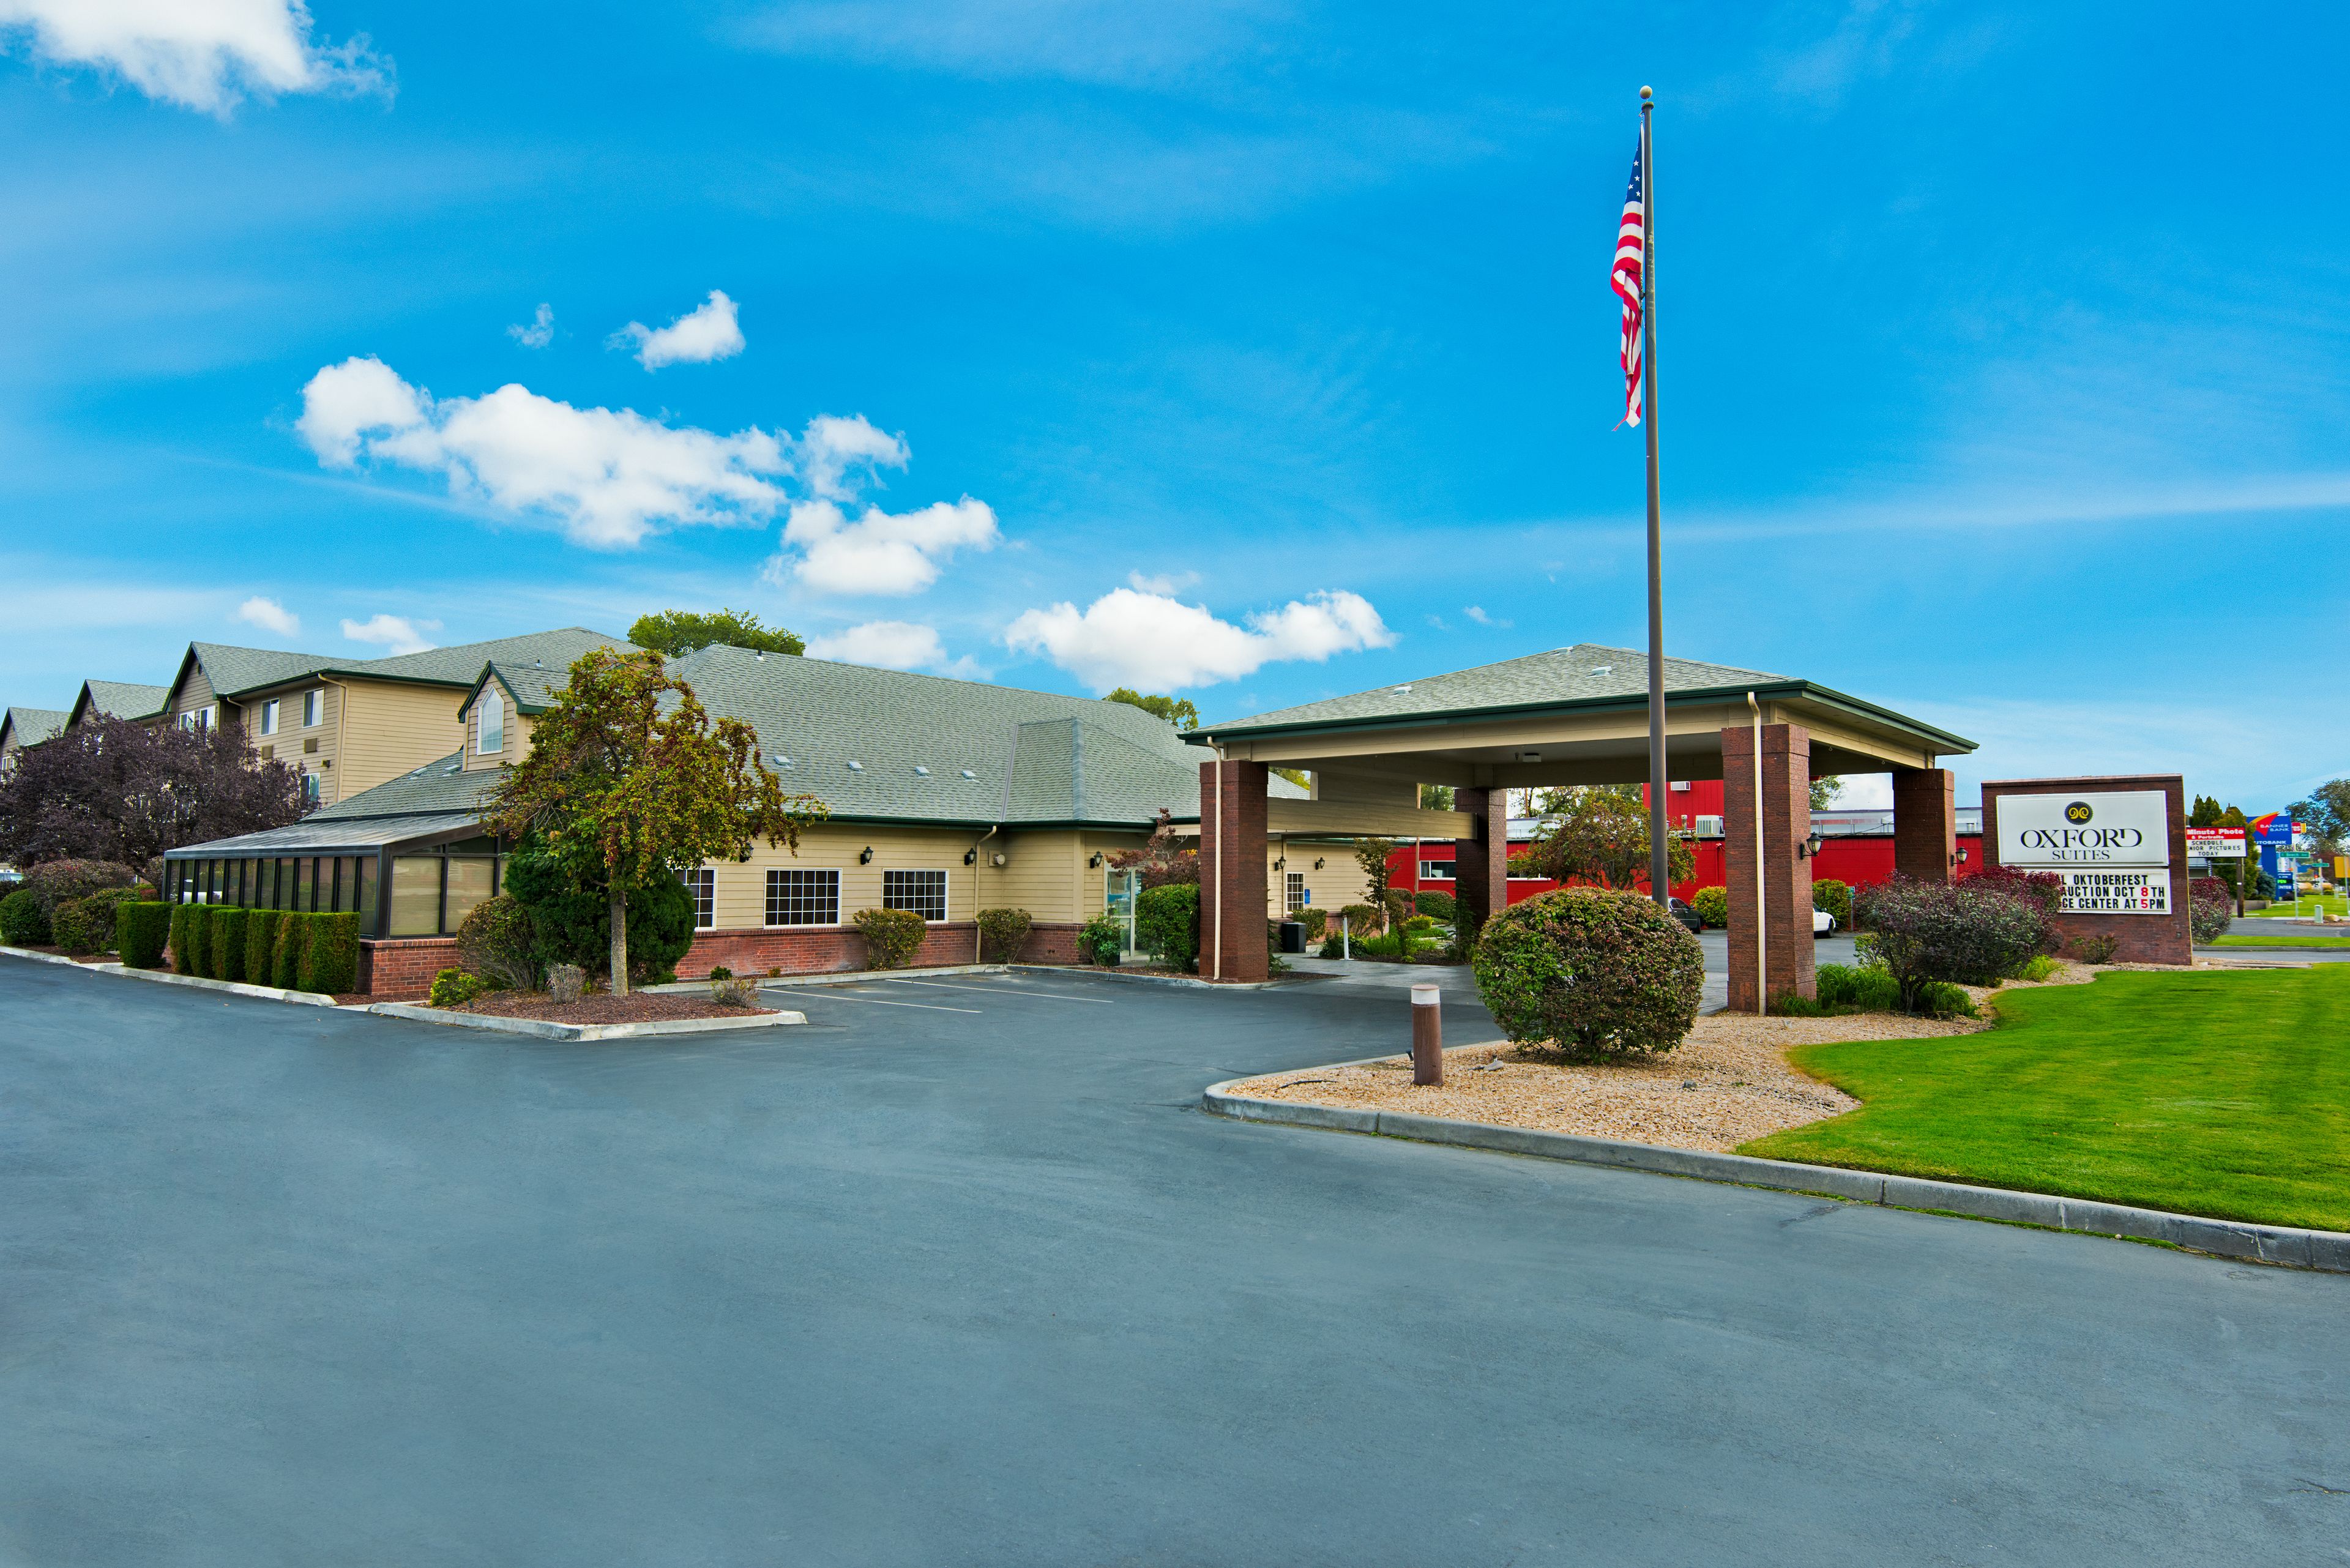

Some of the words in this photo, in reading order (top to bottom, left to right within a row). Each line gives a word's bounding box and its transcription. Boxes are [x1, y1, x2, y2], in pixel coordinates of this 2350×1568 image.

[2020, 829, 2142, 848] OXFORD
[2052, 850, 2109, 860] SUITES
[2073, 875, 2148, 885] OKTOBERFEST
[2061, 886, 2109, 897] AUCTION
[2114, 887, 2135, 897] OCT
[2079, 898, 2119, 908] CENTER
[2124, 899, 2138, 909] AT
